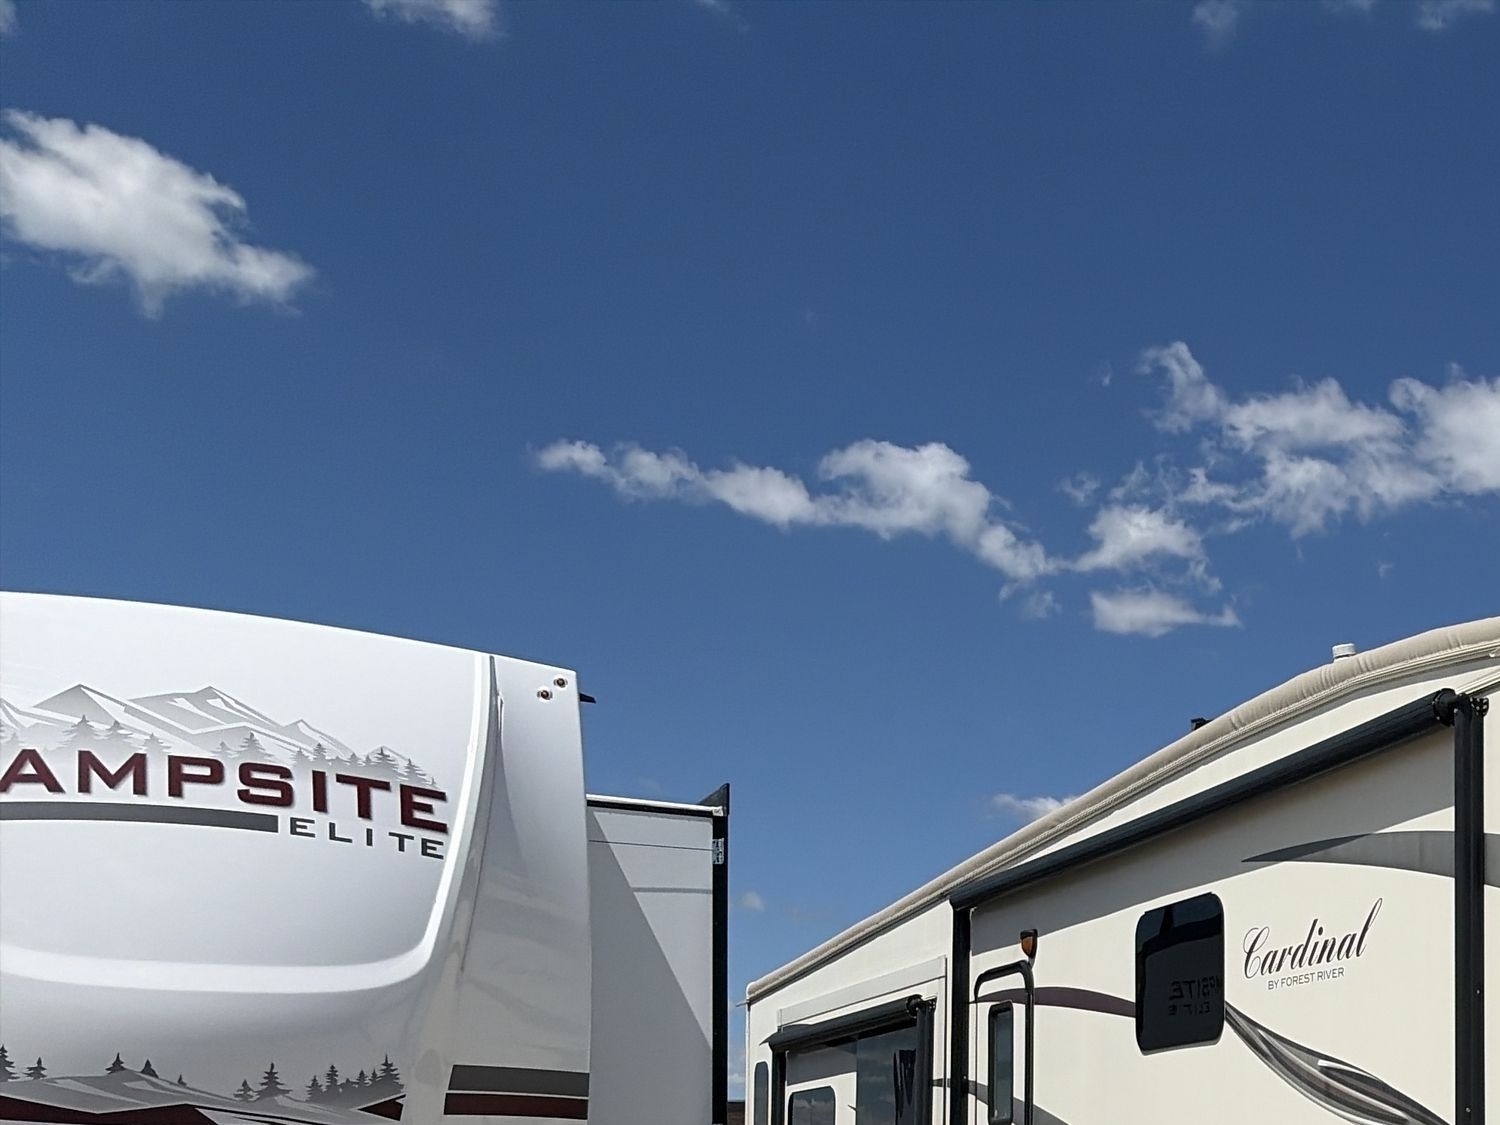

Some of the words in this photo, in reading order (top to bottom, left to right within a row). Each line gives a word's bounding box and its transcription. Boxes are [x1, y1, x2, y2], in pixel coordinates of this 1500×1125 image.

[0, 748, 449, 834] AMPSITE
[289, 817, 445, 860] ELITE
[1243, 897, 1383, 979] Cardinal
[1268, 980, 1279, 991] BY
[1281, 972, 1315, 987] FOREST
[1317, 967, 1345, 981] RIVER
